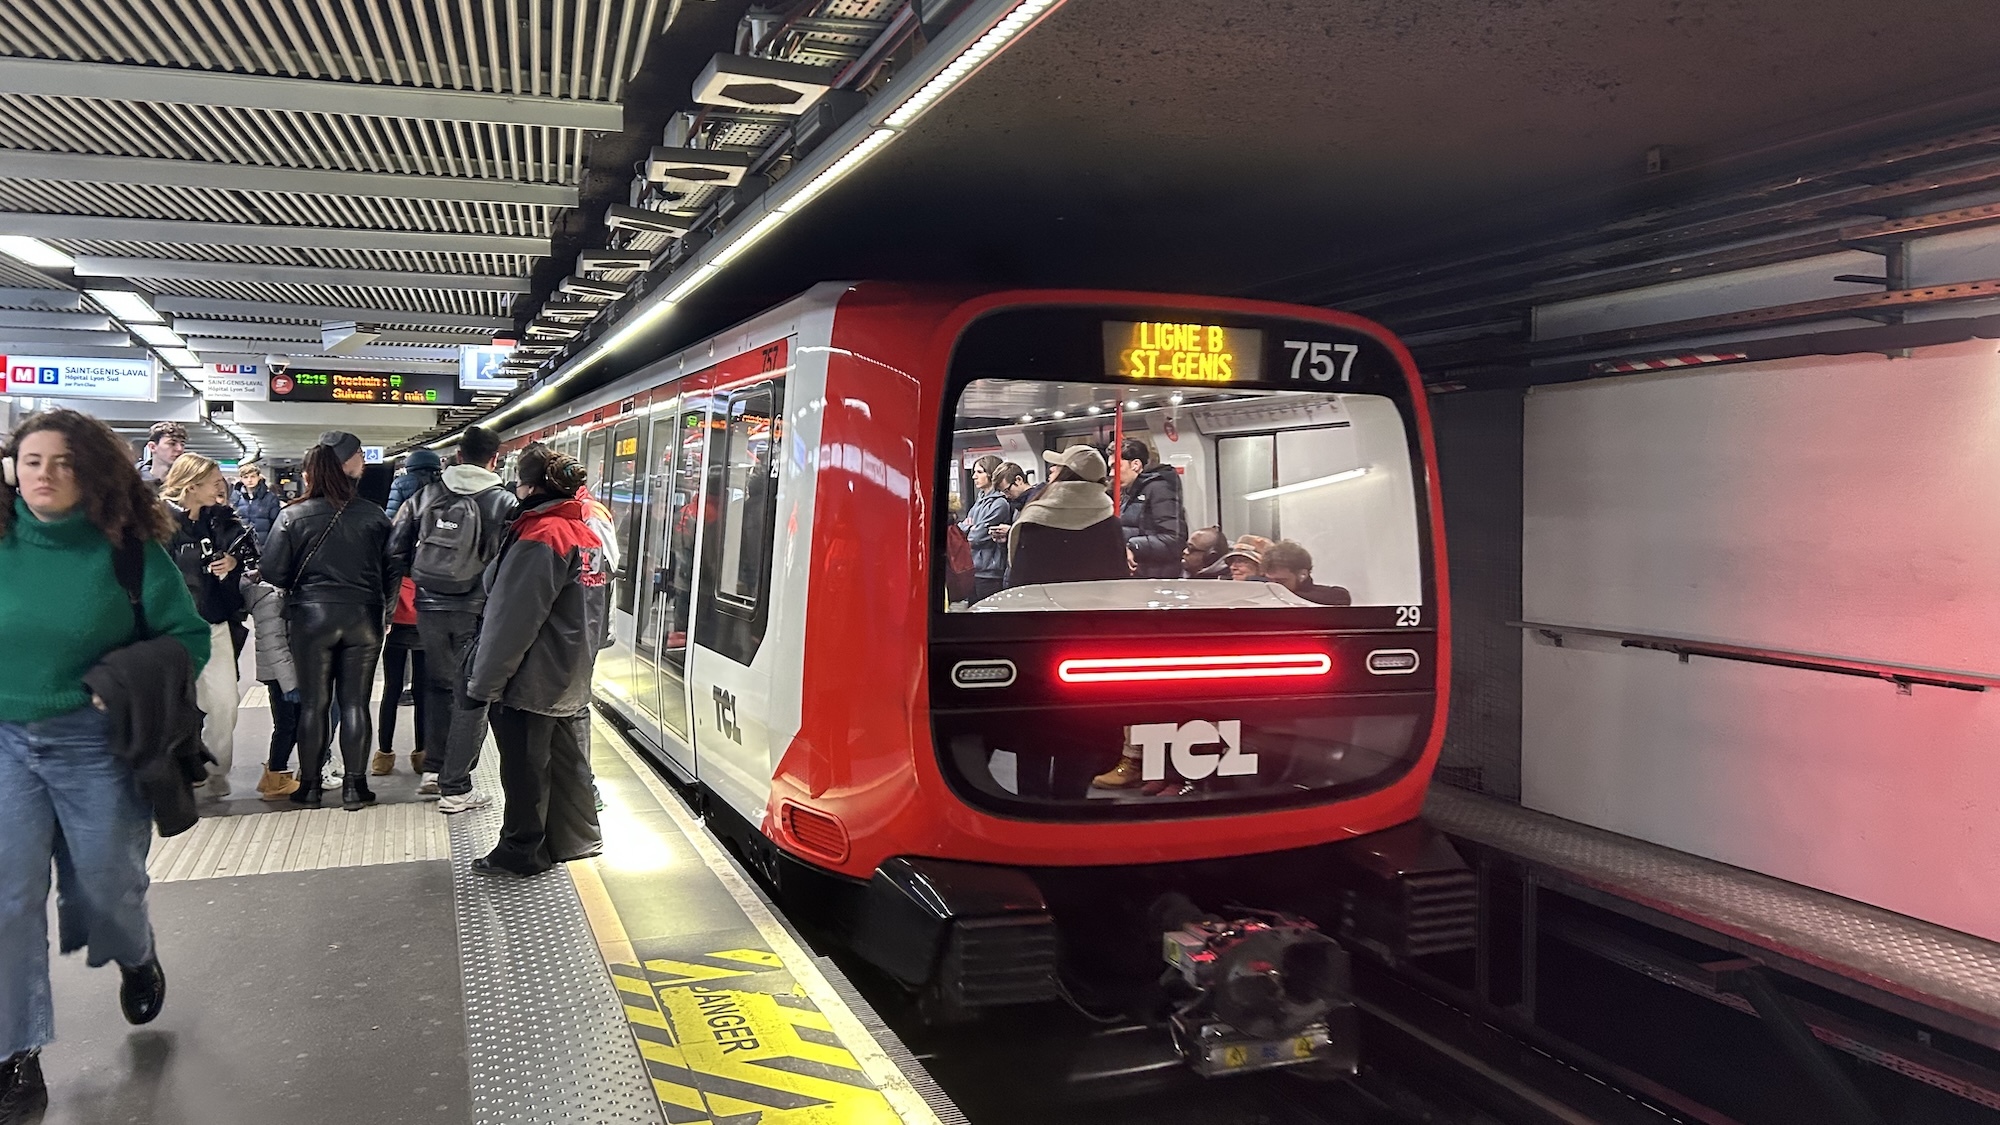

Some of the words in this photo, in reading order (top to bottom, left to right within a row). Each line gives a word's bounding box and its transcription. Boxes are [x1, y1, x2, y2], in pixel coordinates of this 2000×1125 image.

[1140, 322, 1201, 351] LIGNE
[1208, 326, 1224, 353] B
[762, 345, 779, 373] 757
[1130, 349, 1233, 381] ST-GENIS
[1284, 340, 1359, 382] 757
[15, 367, 34, 382] M
[43, 369, 55, 382] B
[65, 366, 148, 378] SAINT-GENIS-LAVAL
[207, 379, 263, 387] SAINT-GENIS-LAVAL
[296, 373, 328, 386] 12:15
[332, 388, 373, 401] Suivant
[390, 390, 400, 401] 2
[404, 390, 425, 402] min
[769, 458, 780, 479] 29
[1395, 605, 1421, 627] 29
[712, 684, 742, 747] TCL
[1130, 719, 1259, 781] TCL
